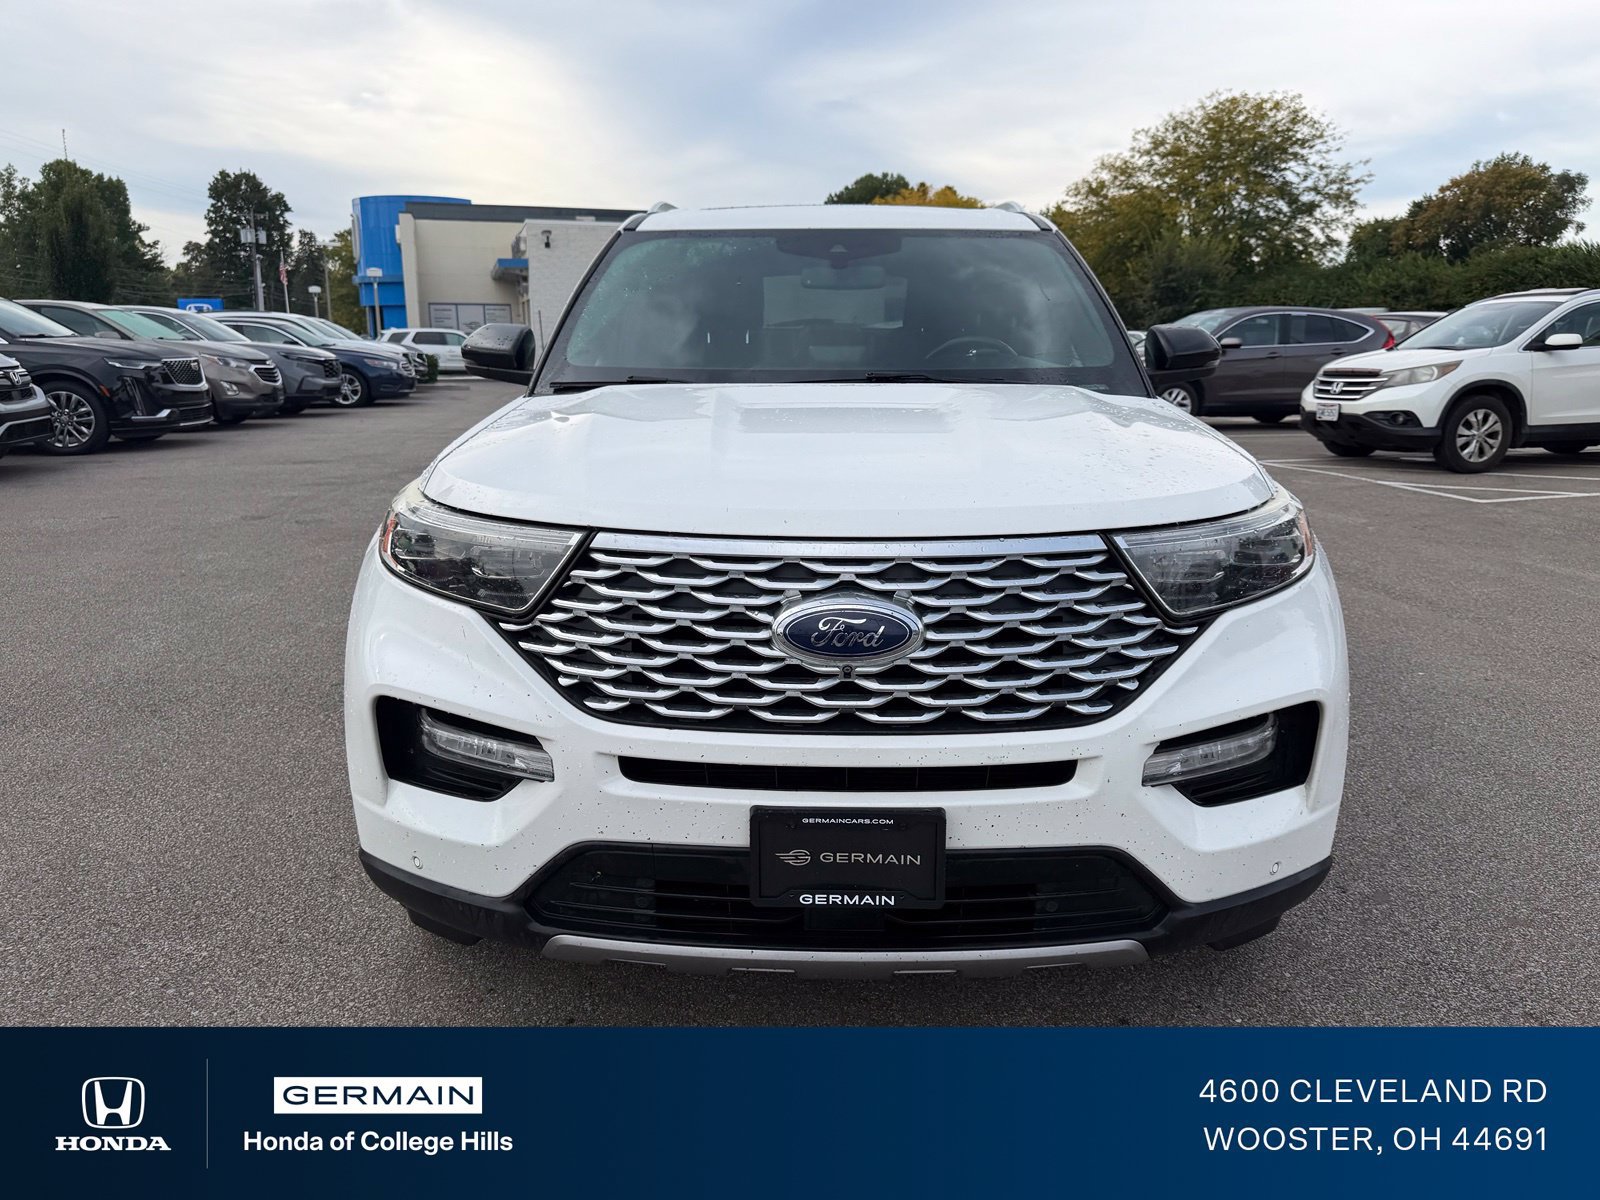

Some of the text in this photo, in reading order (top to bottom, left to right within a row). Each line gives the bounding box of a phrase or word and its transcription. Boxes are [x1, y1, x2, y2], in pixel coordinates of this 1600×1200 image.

[810, 616, 885, 648] Ford
[801, 817, 894, 825] GERMAINCARS.COM
[819, 852, 921, 866] GERMAIN
[799, 893, 895, 906] GERMAIN
